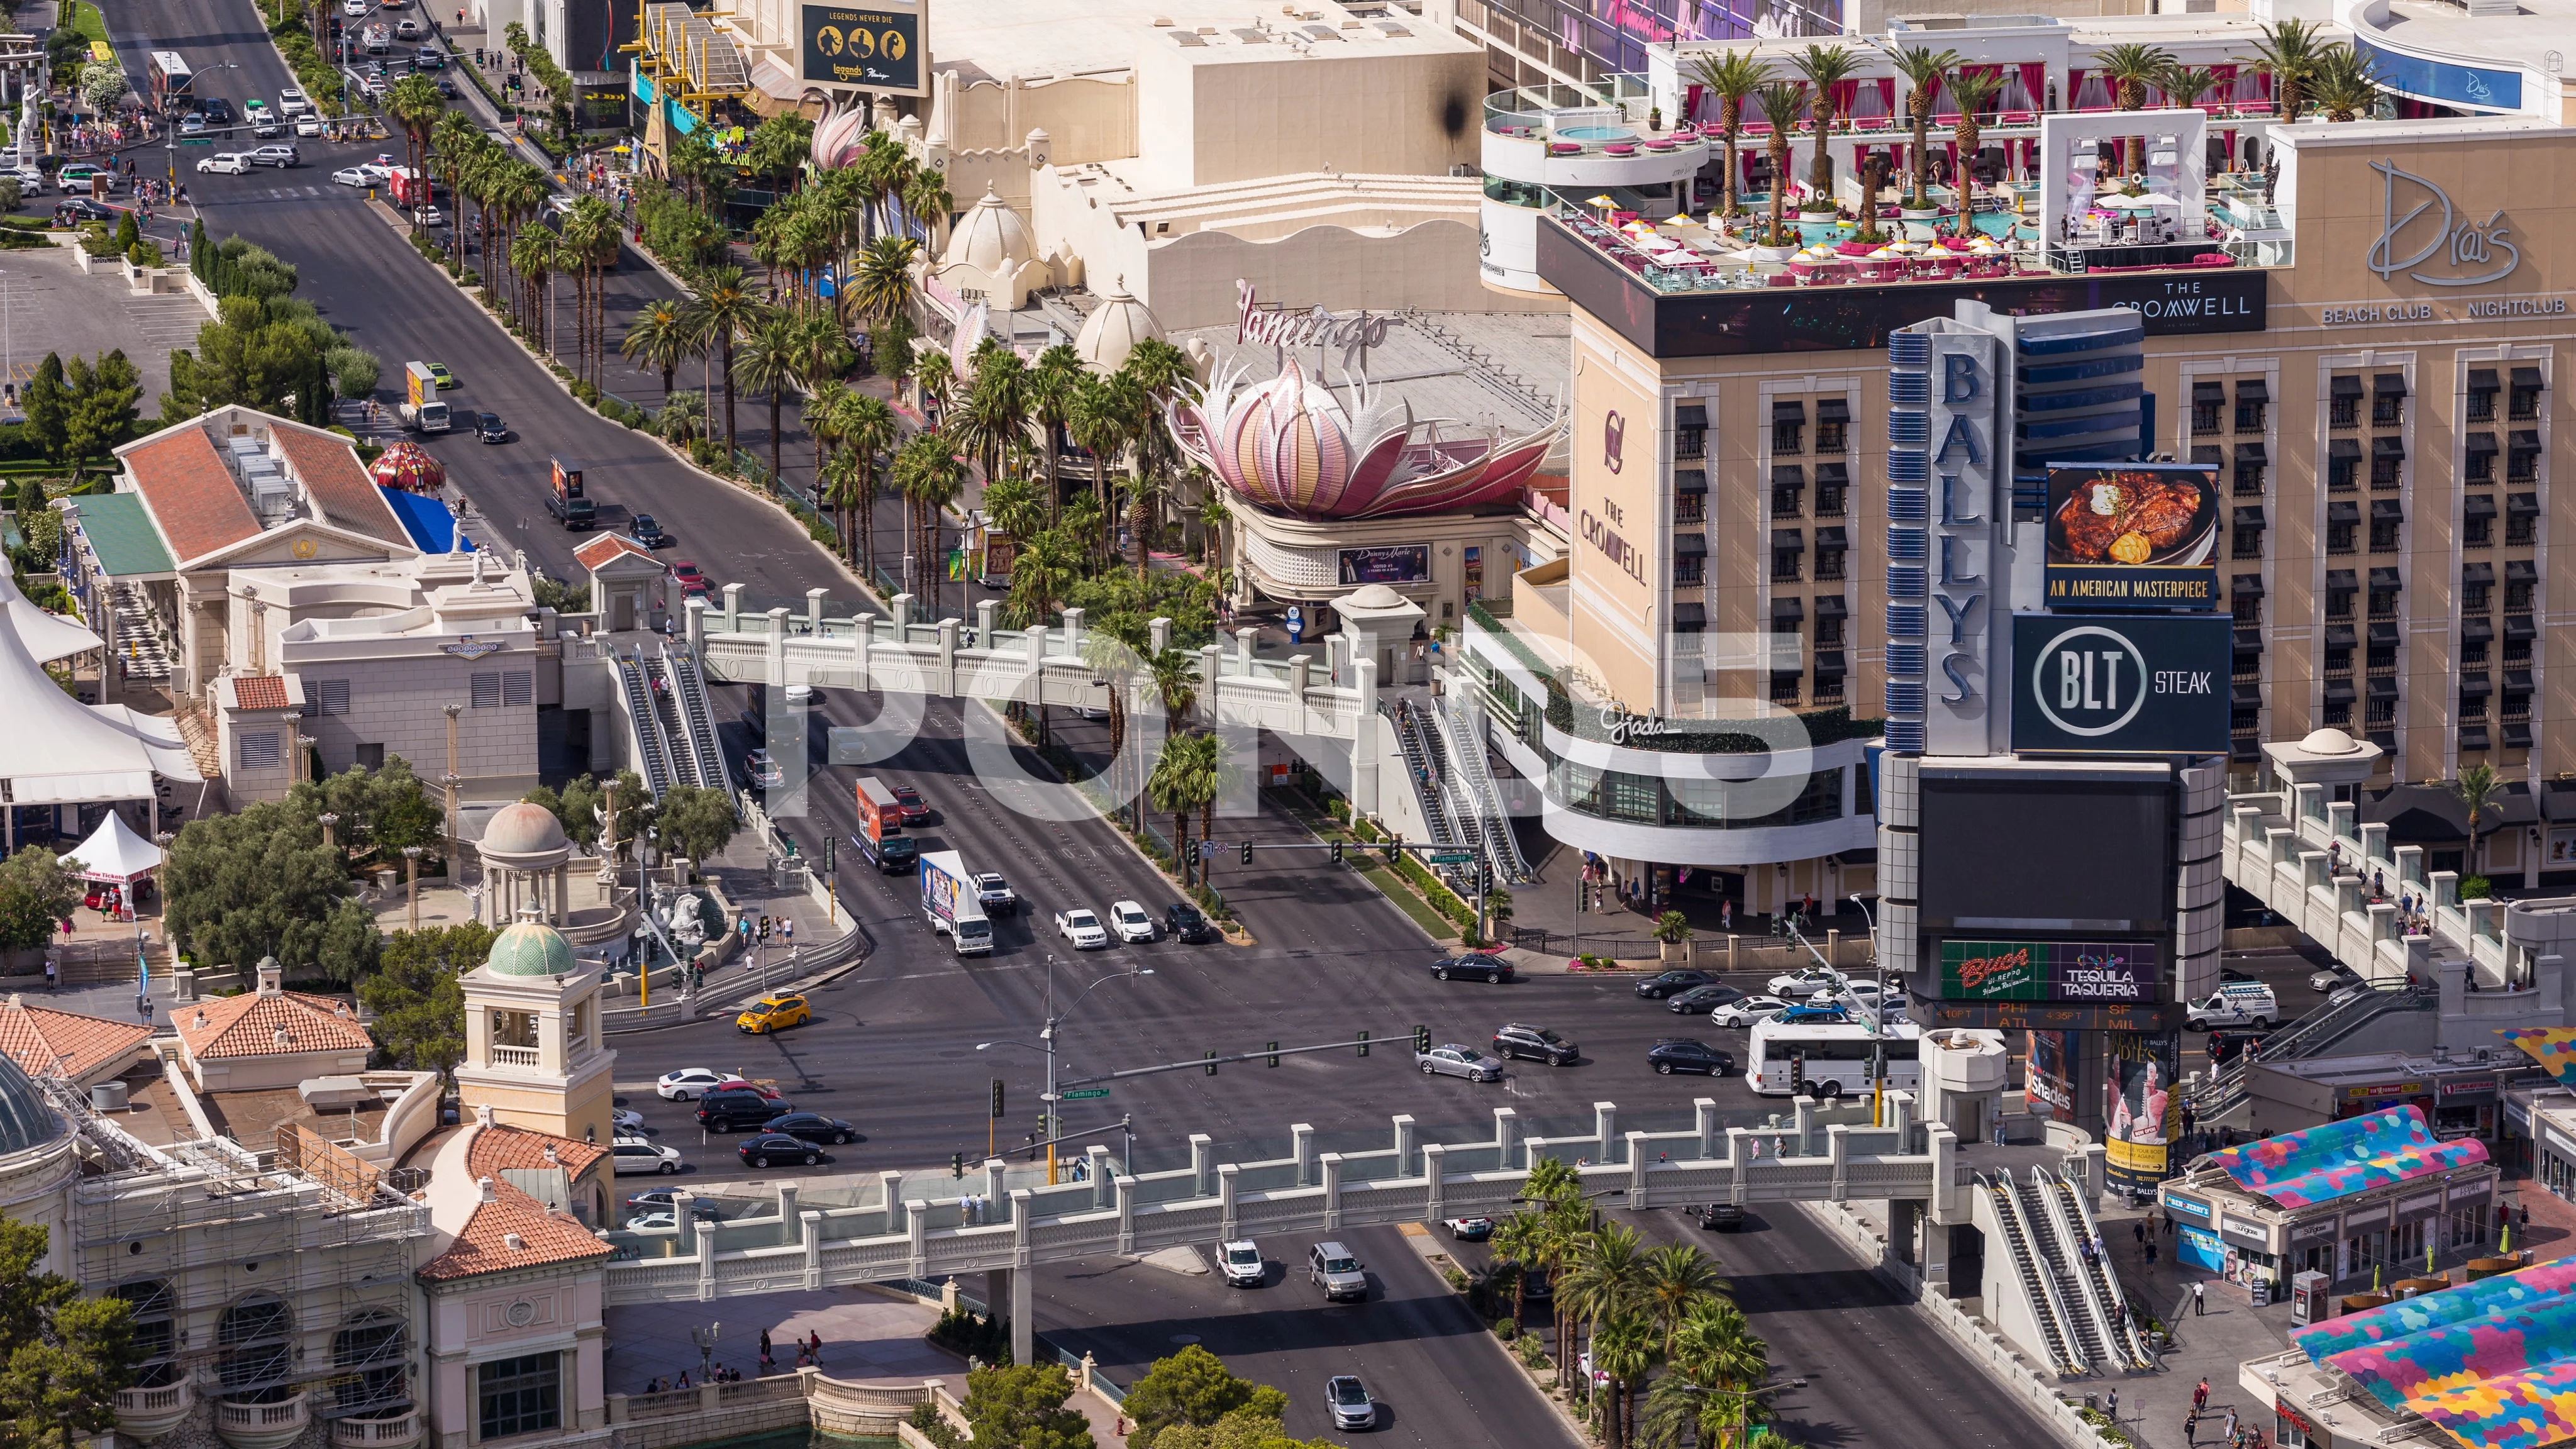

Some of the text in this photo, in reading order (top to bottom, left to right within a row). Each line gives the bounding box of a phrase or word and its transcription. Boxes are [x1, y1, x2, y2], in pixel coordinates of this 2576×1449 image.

[830, 13, 857, 21] LEGENDS
[834, 63, 862, 81] Legends
[585, 74, 621, 85] LINQ
[2466, 70, 2490, 97] Drai's
[2367, 158, 2519, 286] Drai's
[2165, 282, 2200, 294] THE
[2322, 304, 2431, 323] BEACH CLUB
[2468, 298, 2566, 317] NIGHTCLUB
[1604, 497, 1623, 528] THE
[1355, 549, 1386, 560] Donny
[1389, 547, 1410, 558] Marie
[1581, 509, 1646, 587] CROMWELL
[2050, 580, 2208, 597] AN AMERICAN MASTERPIECE
[448, 644, 497, 653] STRIPSIDE
[2060, 651, 2211, 709] BLT STEAK
[1601, 701, 1682, 744] Giada
[96, 806, 106, 815] BAR
[129, 872, 144, 882] WIN
[2067, 970, 2134, 982] TEQUILA
[1982, 975, 2030, 996] Italian Restaurant
[2062, 984, 2138, 996] TAQUERIA
[1999, 1002, 2028, 1013] PHI
[2109, 1005, 2131, 1015] SF
[1999, 1018, 2031, 1028] ATL
[2109, 1019, 2138, 1030] MIL
[2109, 1031, 2148, 1050] REAL
[2043, 1070, 2051, 1079] CAN
[2051, 1074, 2061, 1084] YOU
[2187, 1204, 2208, 1215] JERRY'S
[2235, 1224, 2258, 1235] Sunglass
